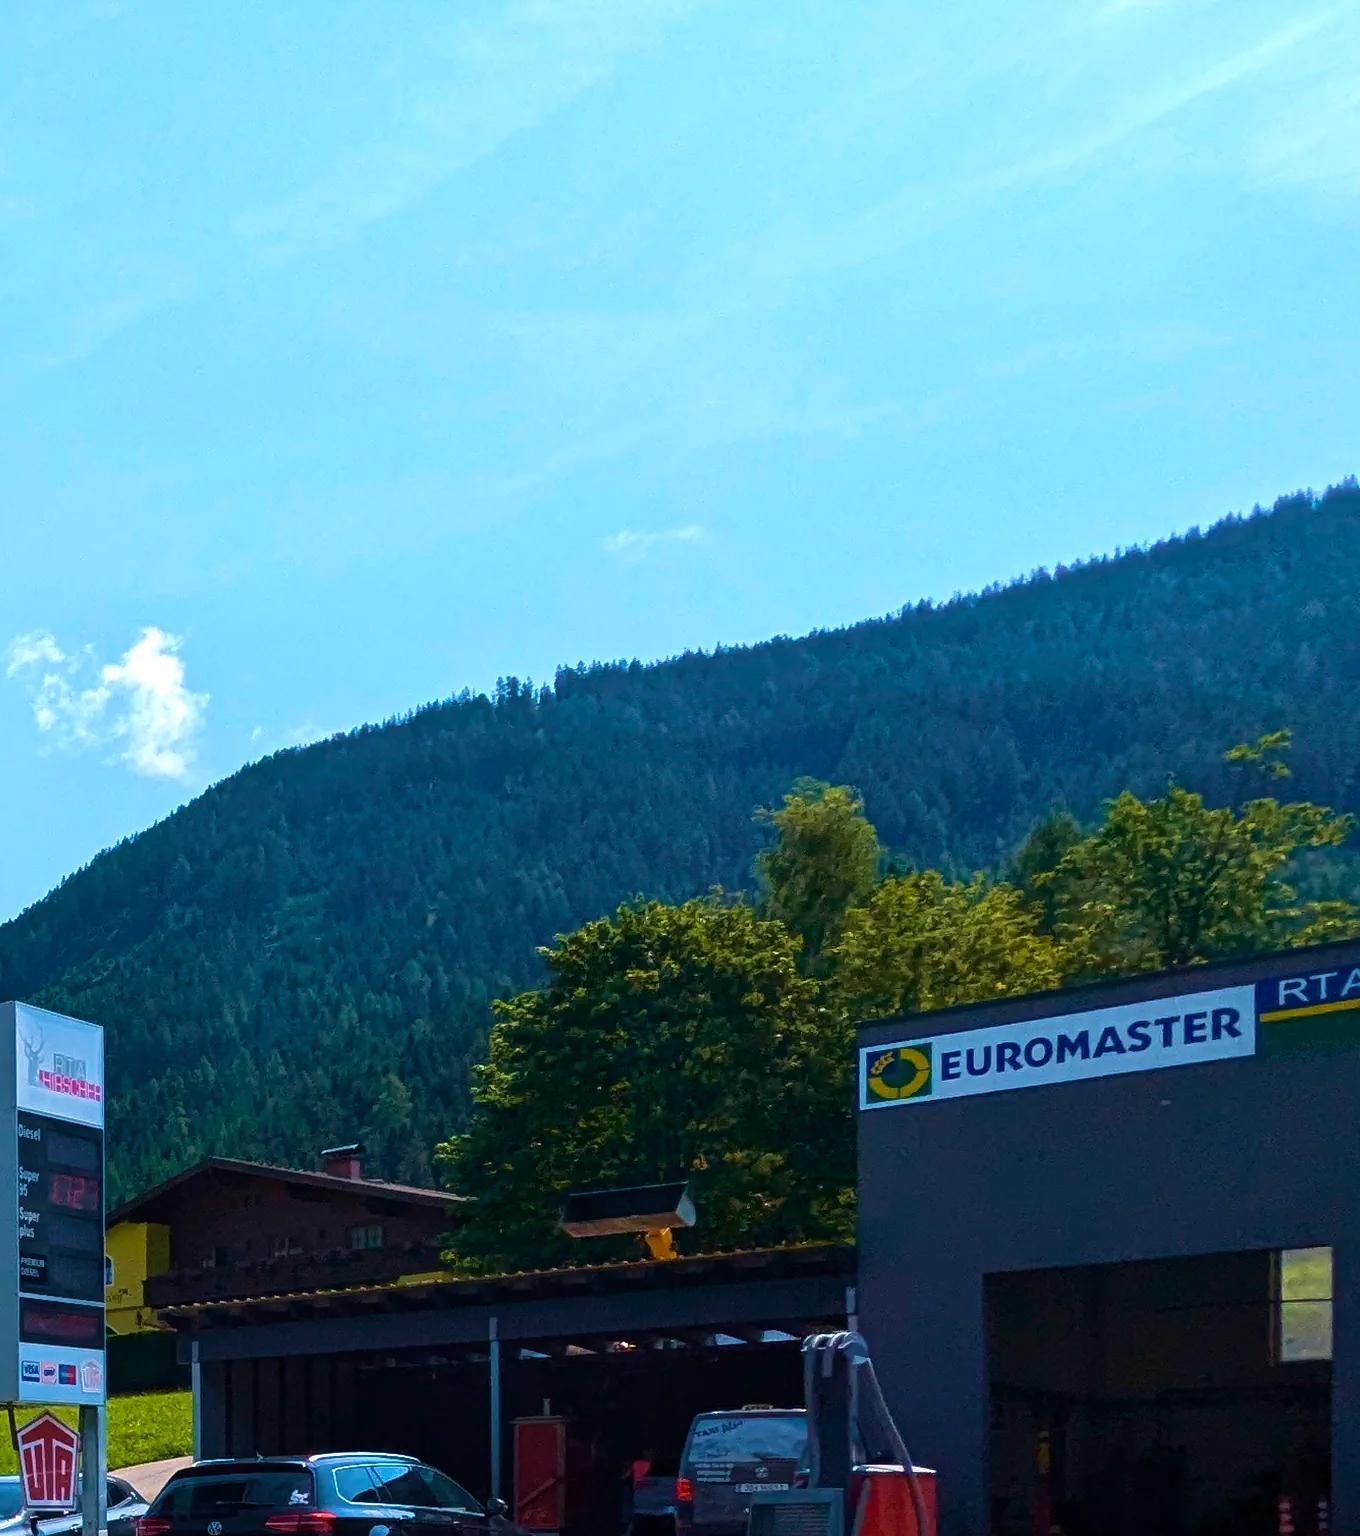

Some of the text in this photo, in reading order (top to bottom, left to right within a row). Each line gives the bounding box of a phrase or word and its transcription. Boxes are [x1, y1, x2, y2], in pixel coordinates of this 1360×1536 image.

[1278, 967, 1360, 1006] RTA
[940, 1007, 1243, 1082] EUROMASTER
[18, 1124, 41, 1141] Diesel
[19, 1166, 39, 1183] Super
[19, 1206, 40, 1224] Super
